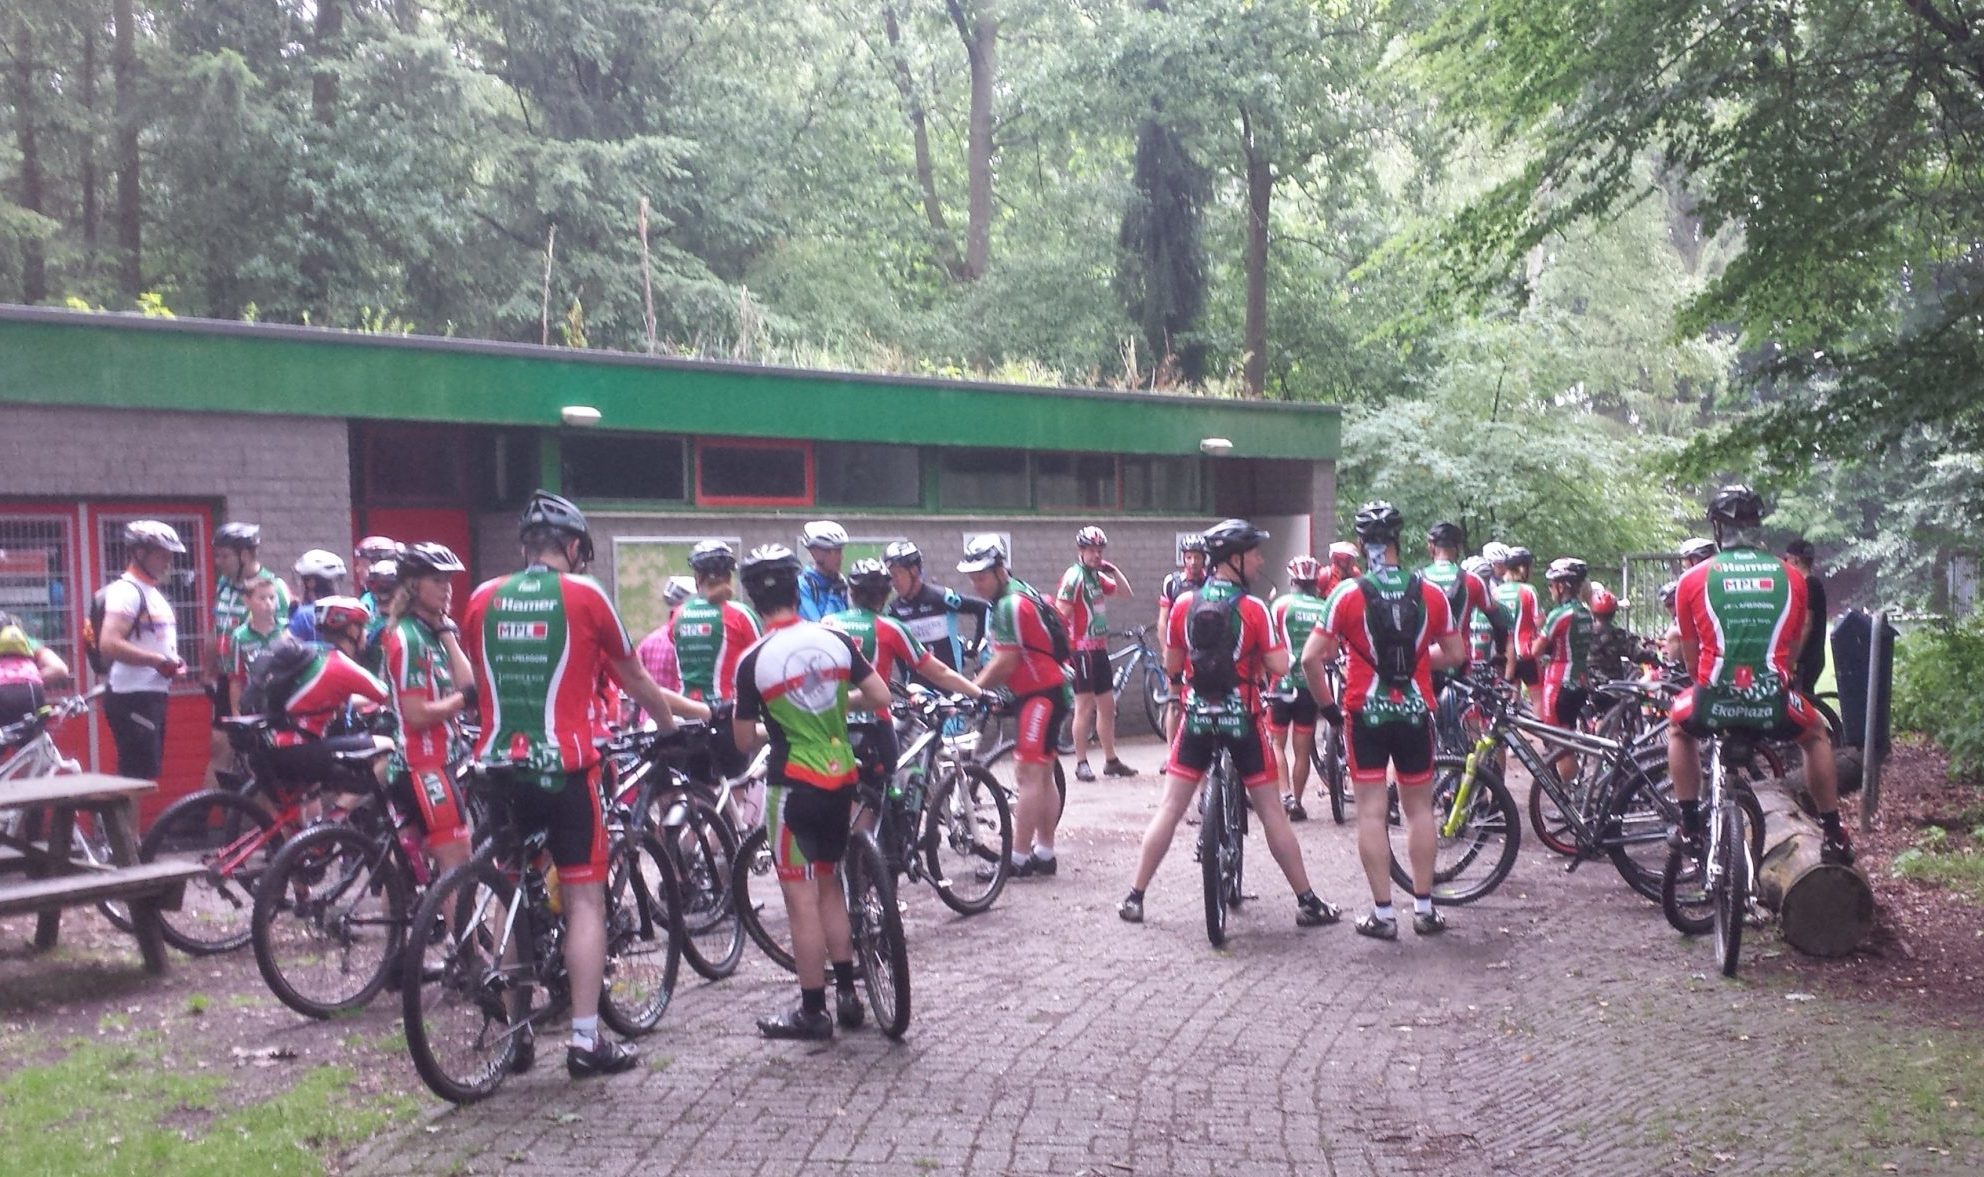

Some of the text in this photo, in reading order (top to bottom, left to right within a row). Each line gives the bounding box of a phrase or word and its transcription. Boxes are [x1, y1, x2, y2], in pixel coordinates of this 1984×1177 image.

[1722, 562, 1780, 573] Hamer
[501, 597, 558, 612] Hamer
[1711, 703, 1773, 718] EkoPlaza
